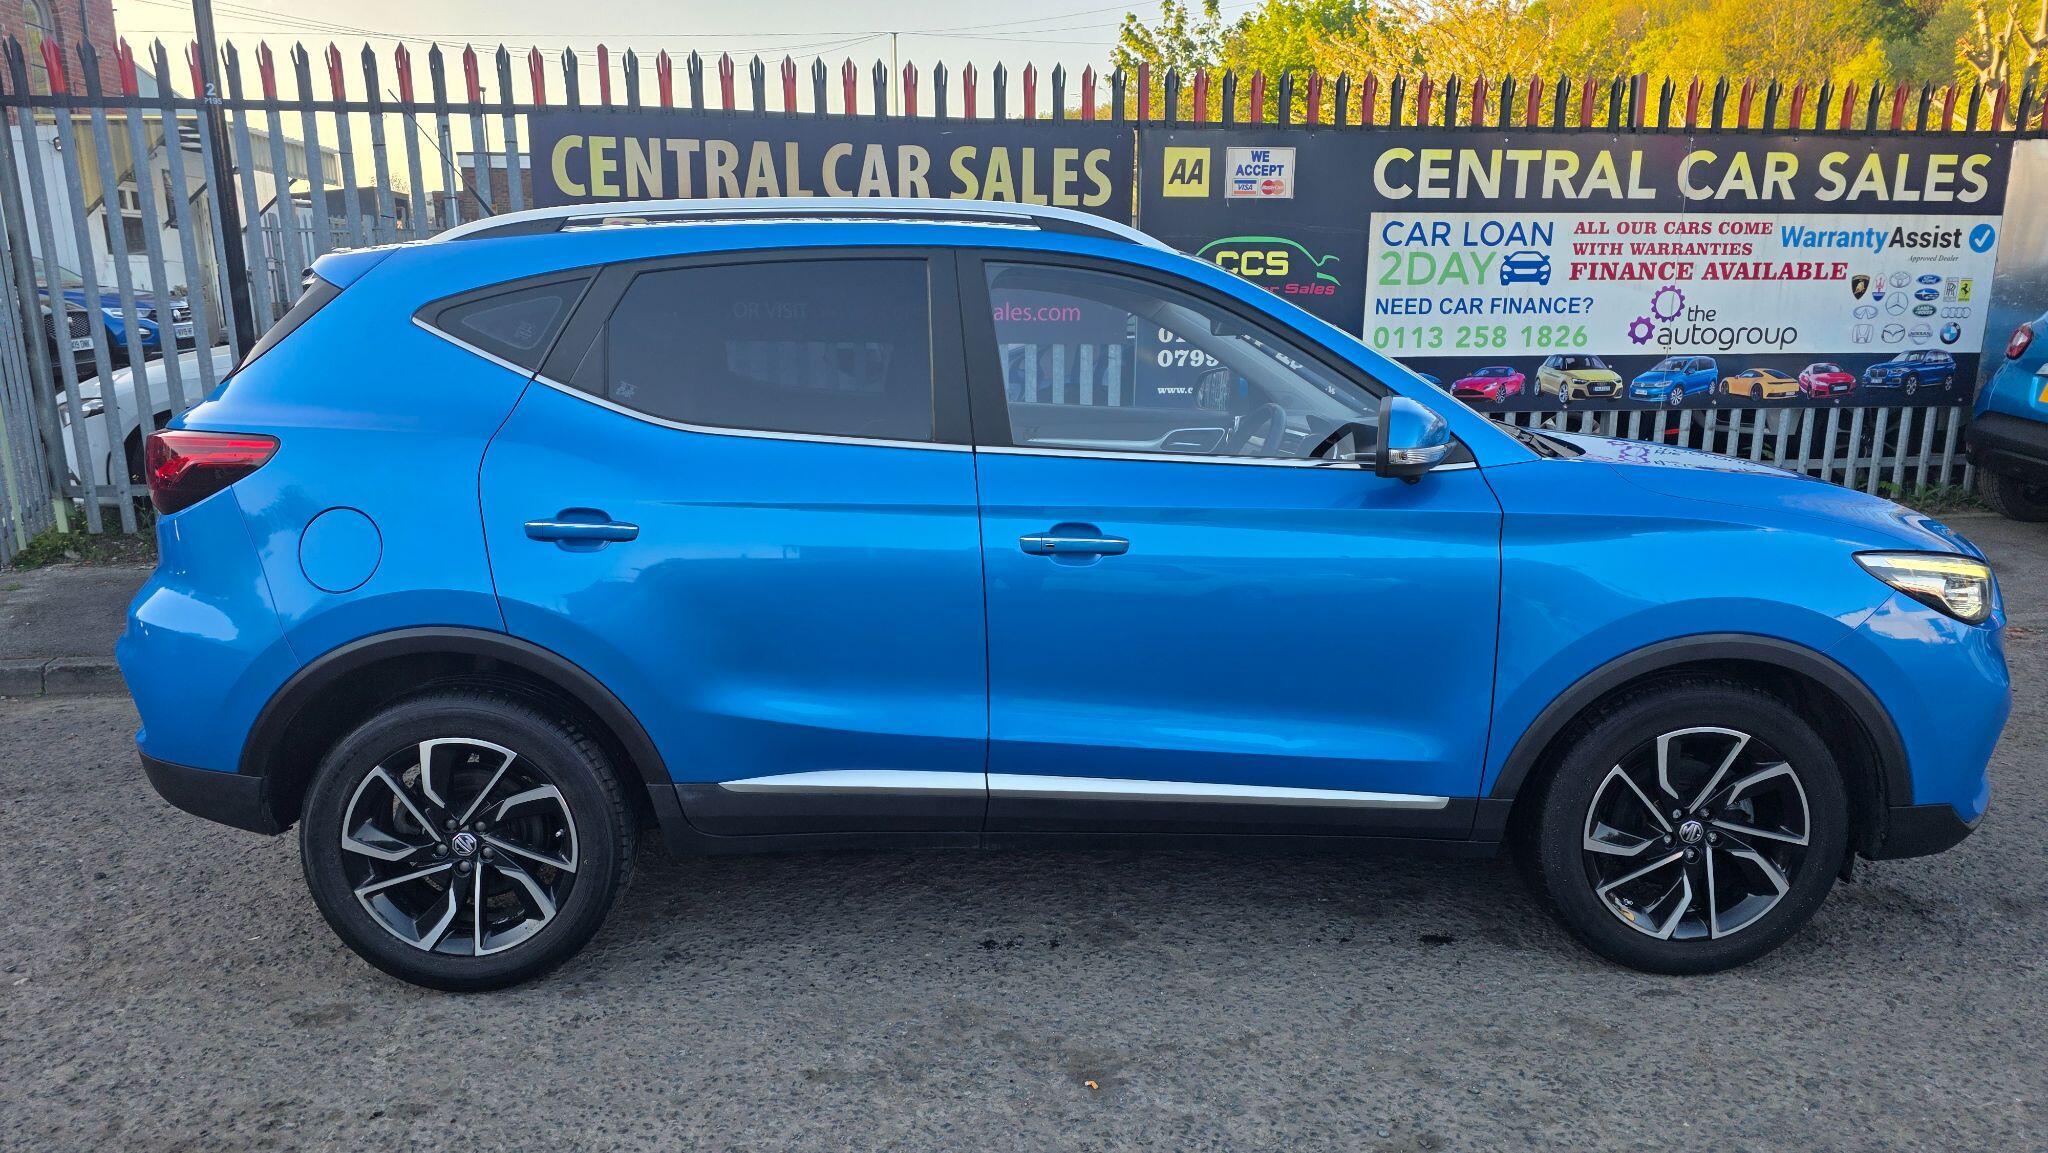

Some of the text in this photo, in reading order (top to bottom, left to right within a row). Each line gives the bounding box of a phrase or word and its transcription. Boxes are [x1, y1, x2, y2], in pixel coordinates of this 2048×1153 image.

[206, 82, 216, 96] 2
[1251, 151, 1270, 163] WE
[551, 134, 1112, 207] CENTRAL CAR SALES
[1168, 158, 1204, 185] AA
[1235, 164, 1284, 176] ACCEPT
[1373, 147, 1992, 203] CENTRAL CAR SALES
[1382, 220, 1554, 247] CAR LOAN
[1573, 221, 1774, 235] ALL OUR CARS COME
[1572, 242, 1753, 256] WITH WARRANTIES
[1780, 225, 1962, 254] WarrantyAssist
[1215, 250, 1289, 276] CCS
[1378, 251, 1498, 286] 2DAY
[1568, 262, 1849, 281] FINANCE AVAILABLE
[1284, 282, 1336, 295] Sales
[993, 301, 1080, 321] ales.com
[1375, 297, 1594, 315] NEED CAR FINANCE?
[1687, 305, 1717, 322] the
[1373, 325, 1588, 349] 0113 258 1826
[1657, 326, 1798, 351] autogroup
